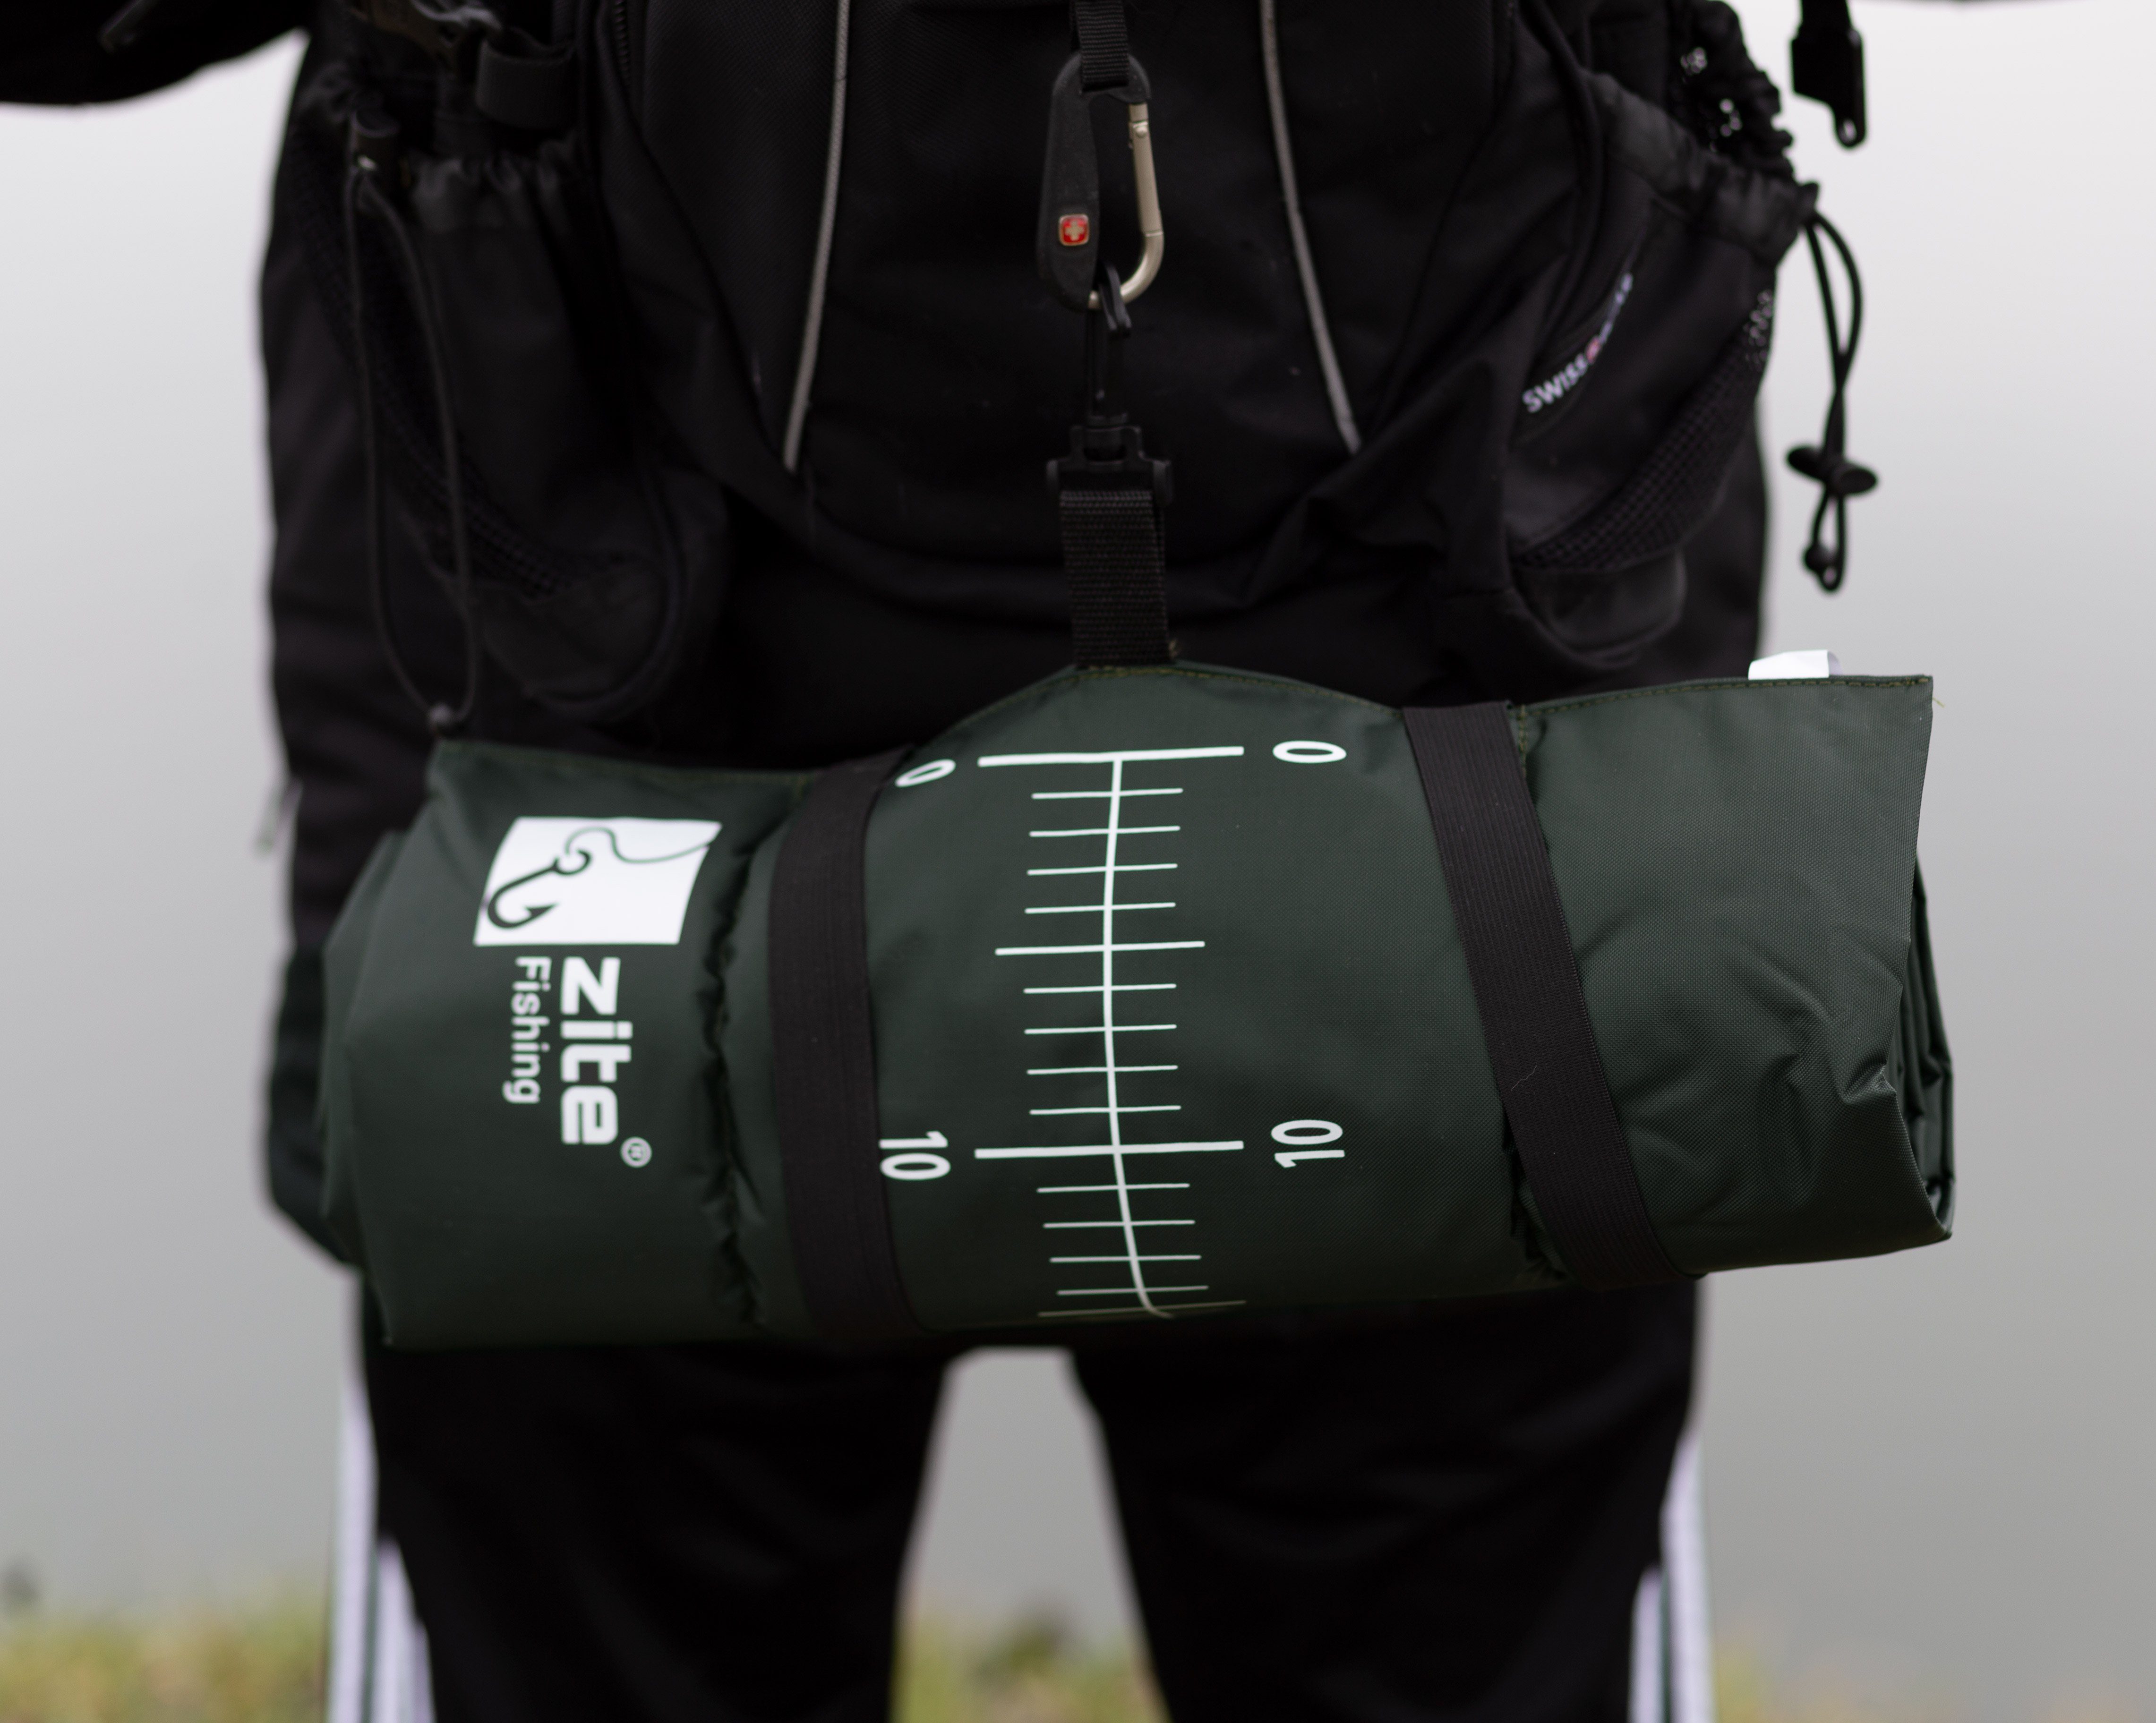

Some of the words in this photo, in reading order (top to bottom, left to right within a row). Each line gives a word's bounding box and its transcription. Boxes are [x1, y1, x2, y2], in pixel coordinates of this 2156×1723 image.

[896, 759, 956, 787] 0
[1272, 740, 1347, 764] 0
[502, 956, 552, 1104] Fishing
[879, 1130, 951, 1181] 10
[1271, 1119, 1345, 1168] 10
